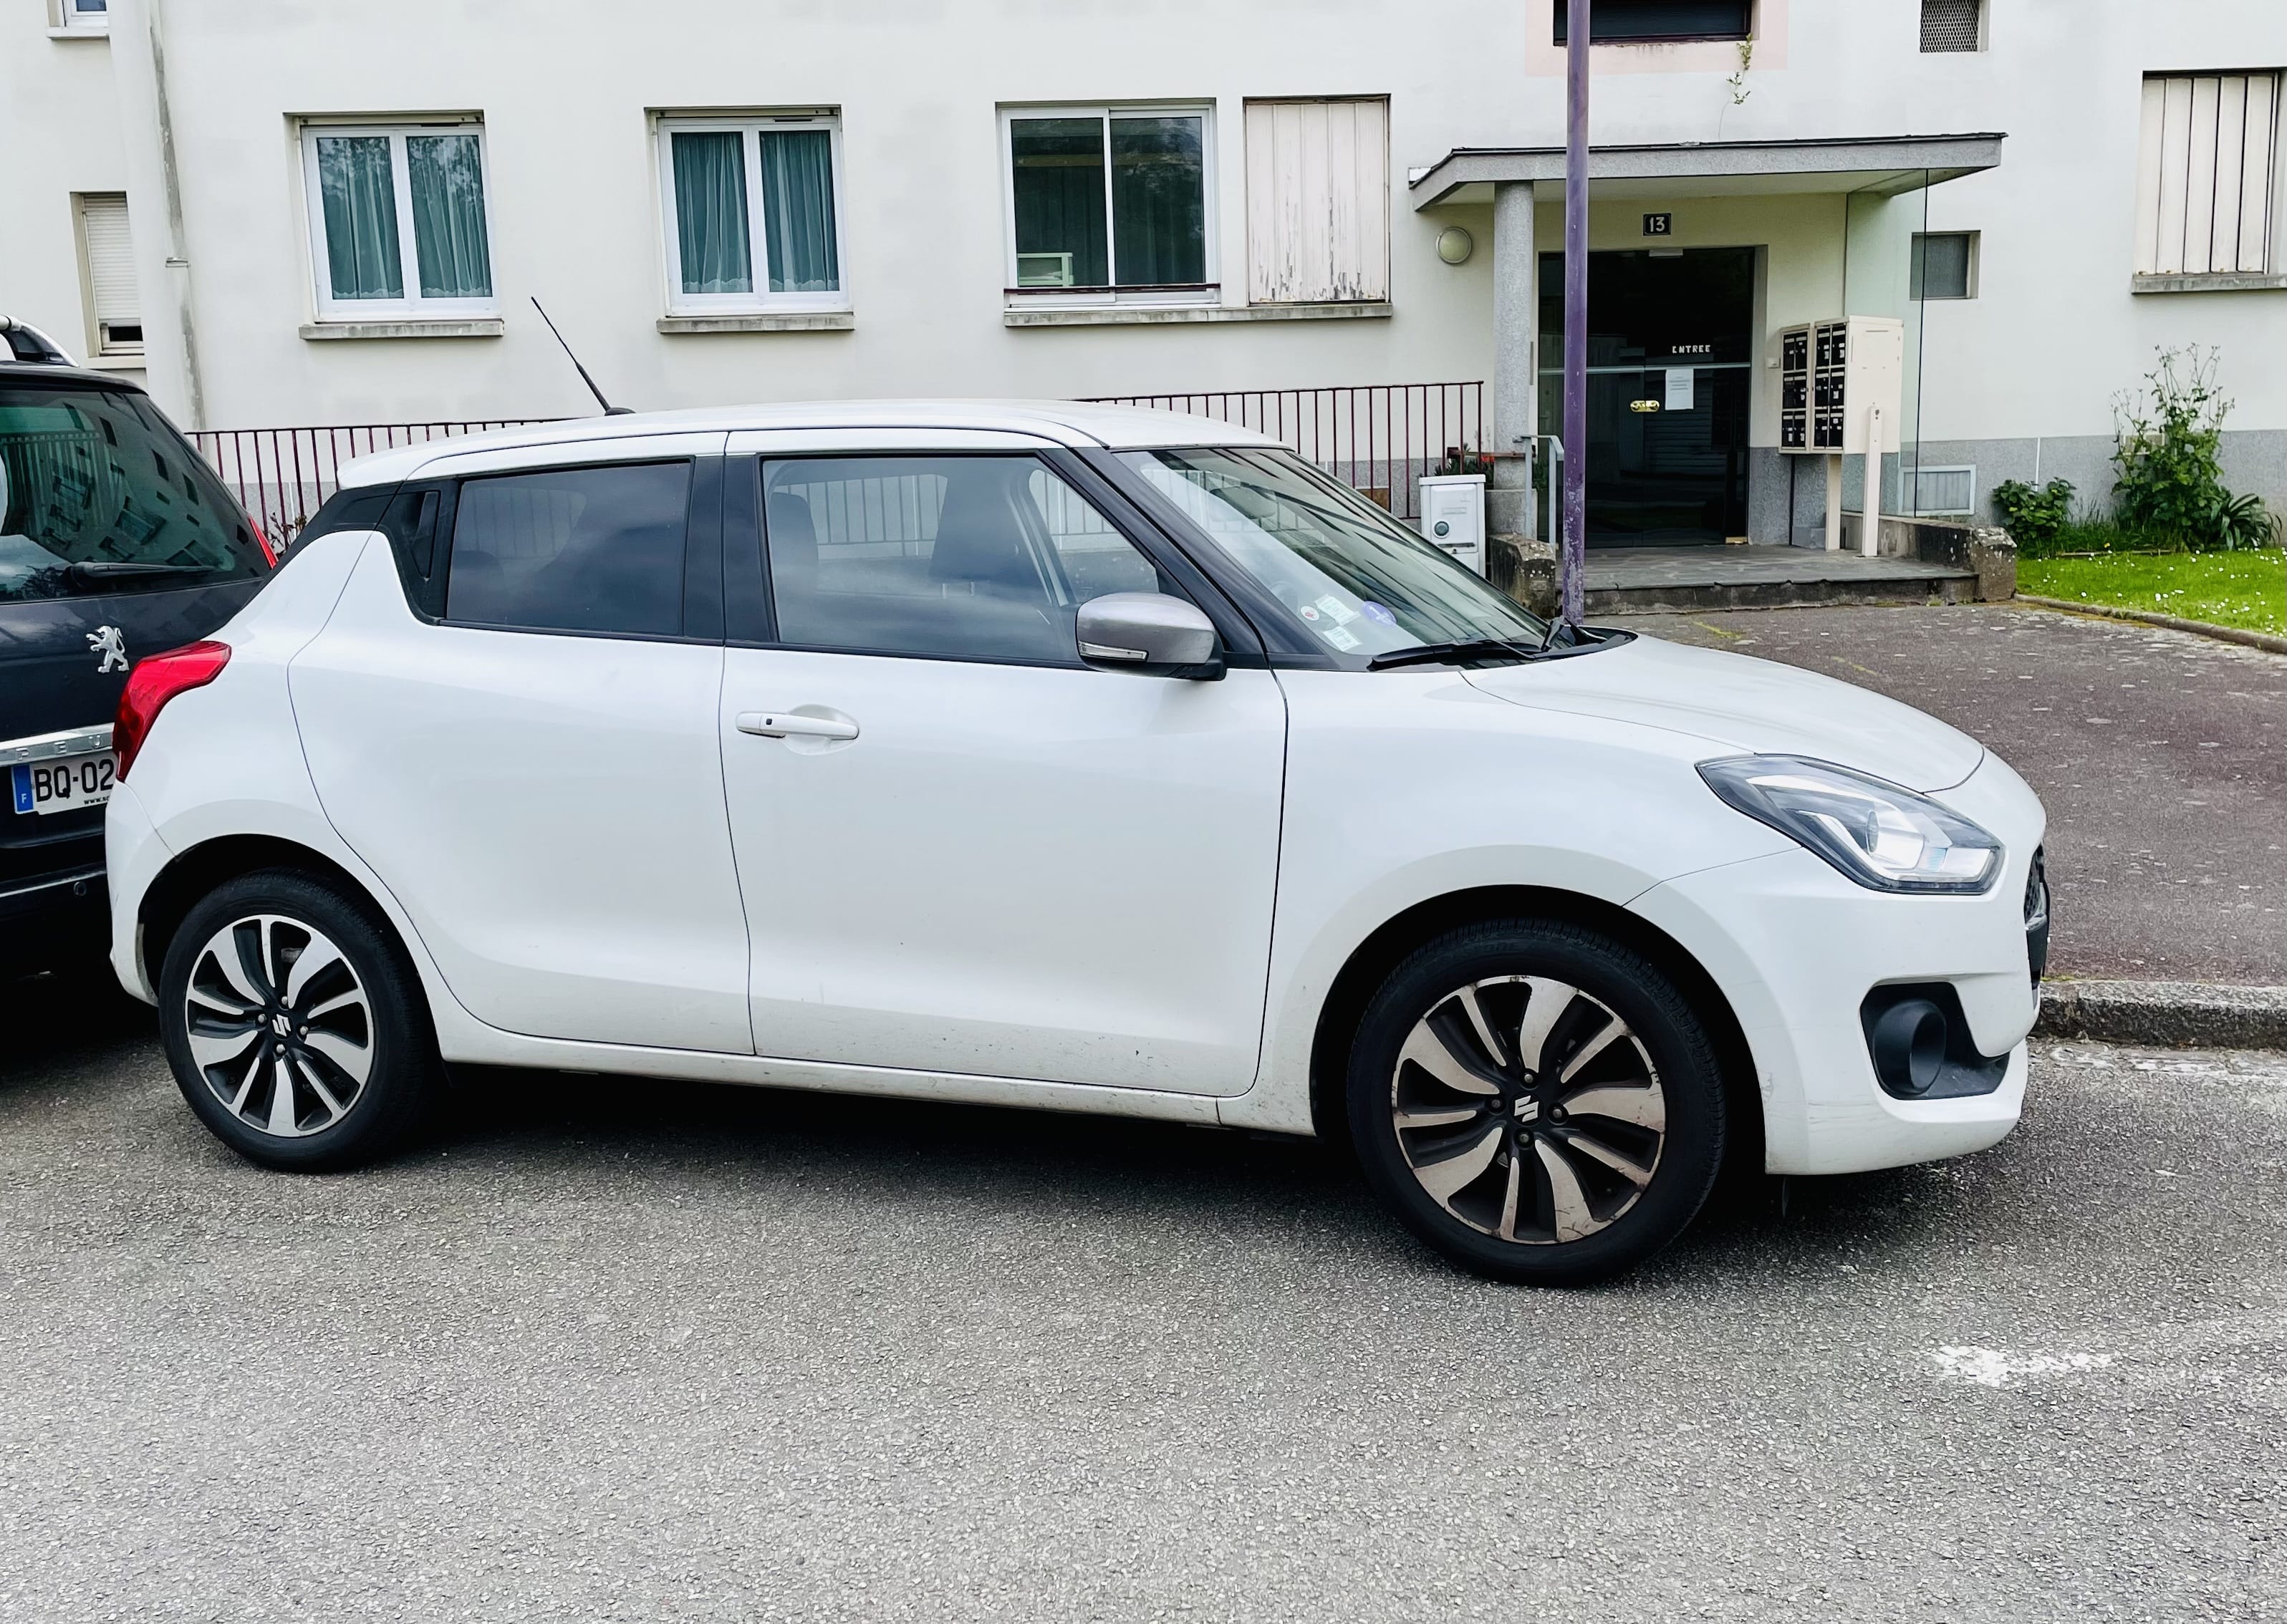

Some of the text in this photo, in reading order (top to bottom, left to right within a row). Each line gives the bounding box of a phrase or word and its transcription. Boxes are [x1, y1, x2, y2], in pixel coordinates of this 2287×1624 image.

[1650, 216, 1665, 233] 13
[1672, 344, 1711, 354] ENTREE
[21, 793, 27, 804] F
